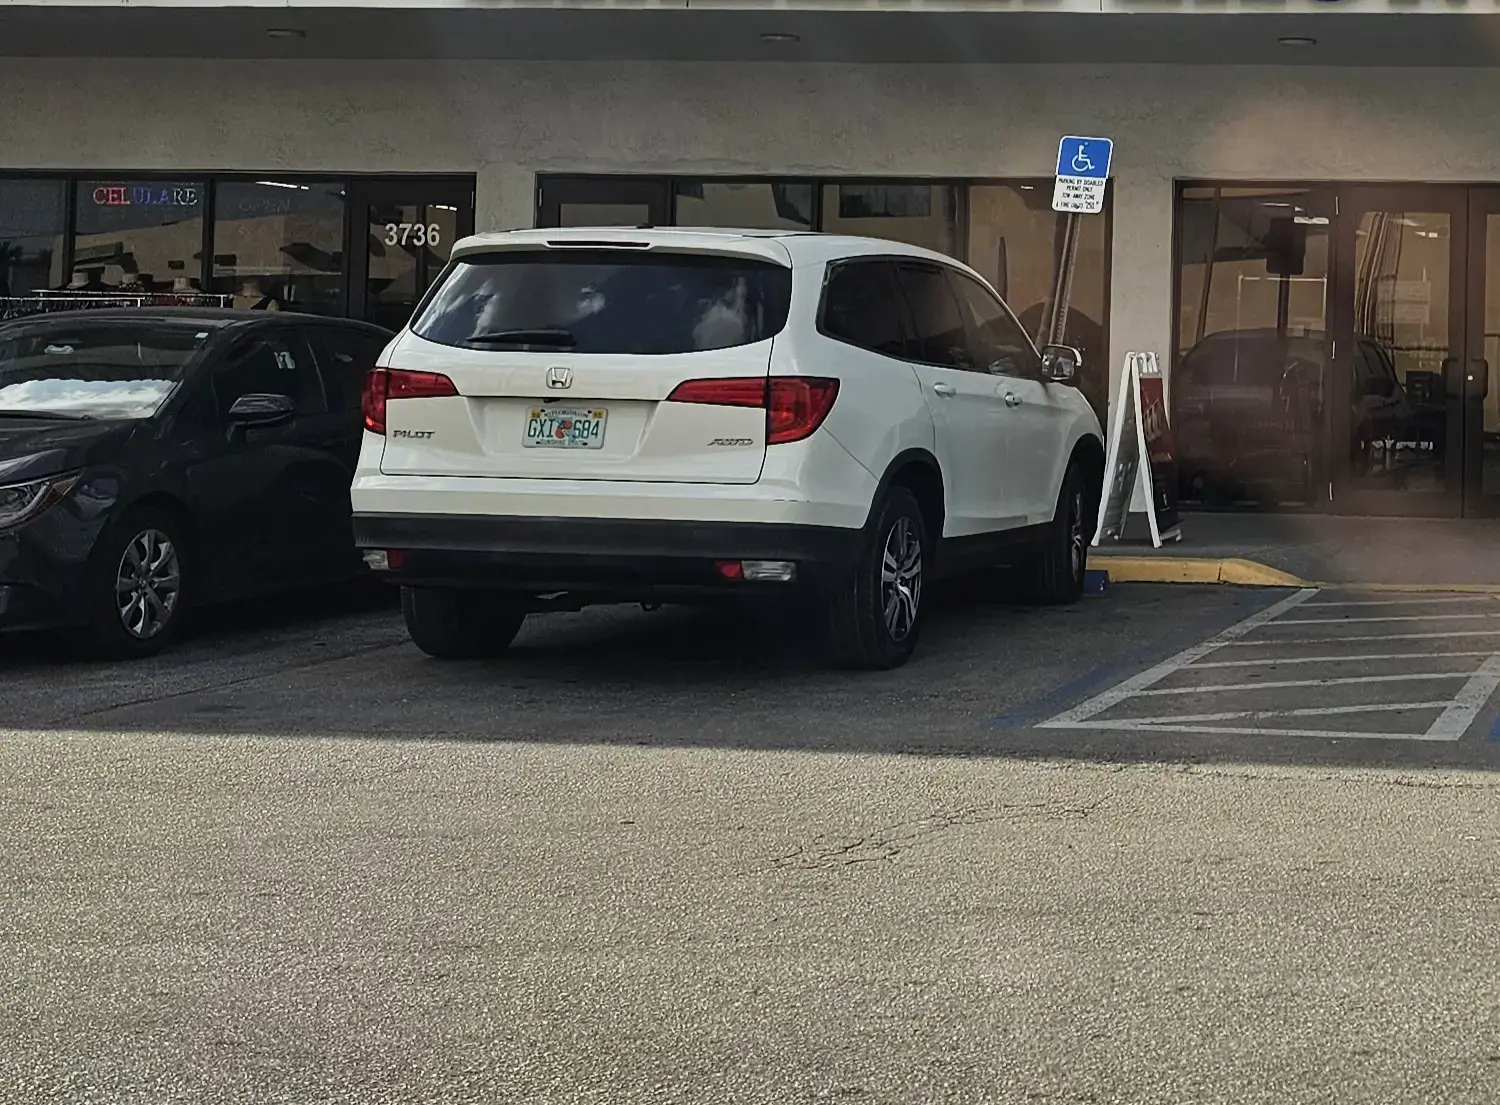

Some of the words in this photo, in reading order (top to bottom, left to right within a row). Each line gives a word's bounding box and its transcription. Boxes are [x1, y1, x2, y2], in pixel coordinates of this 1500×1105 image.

[383, 223, 441, 247] 3736
[393, 429, 436, 439] PILOT
[706, 438, 754, 447] AWD
